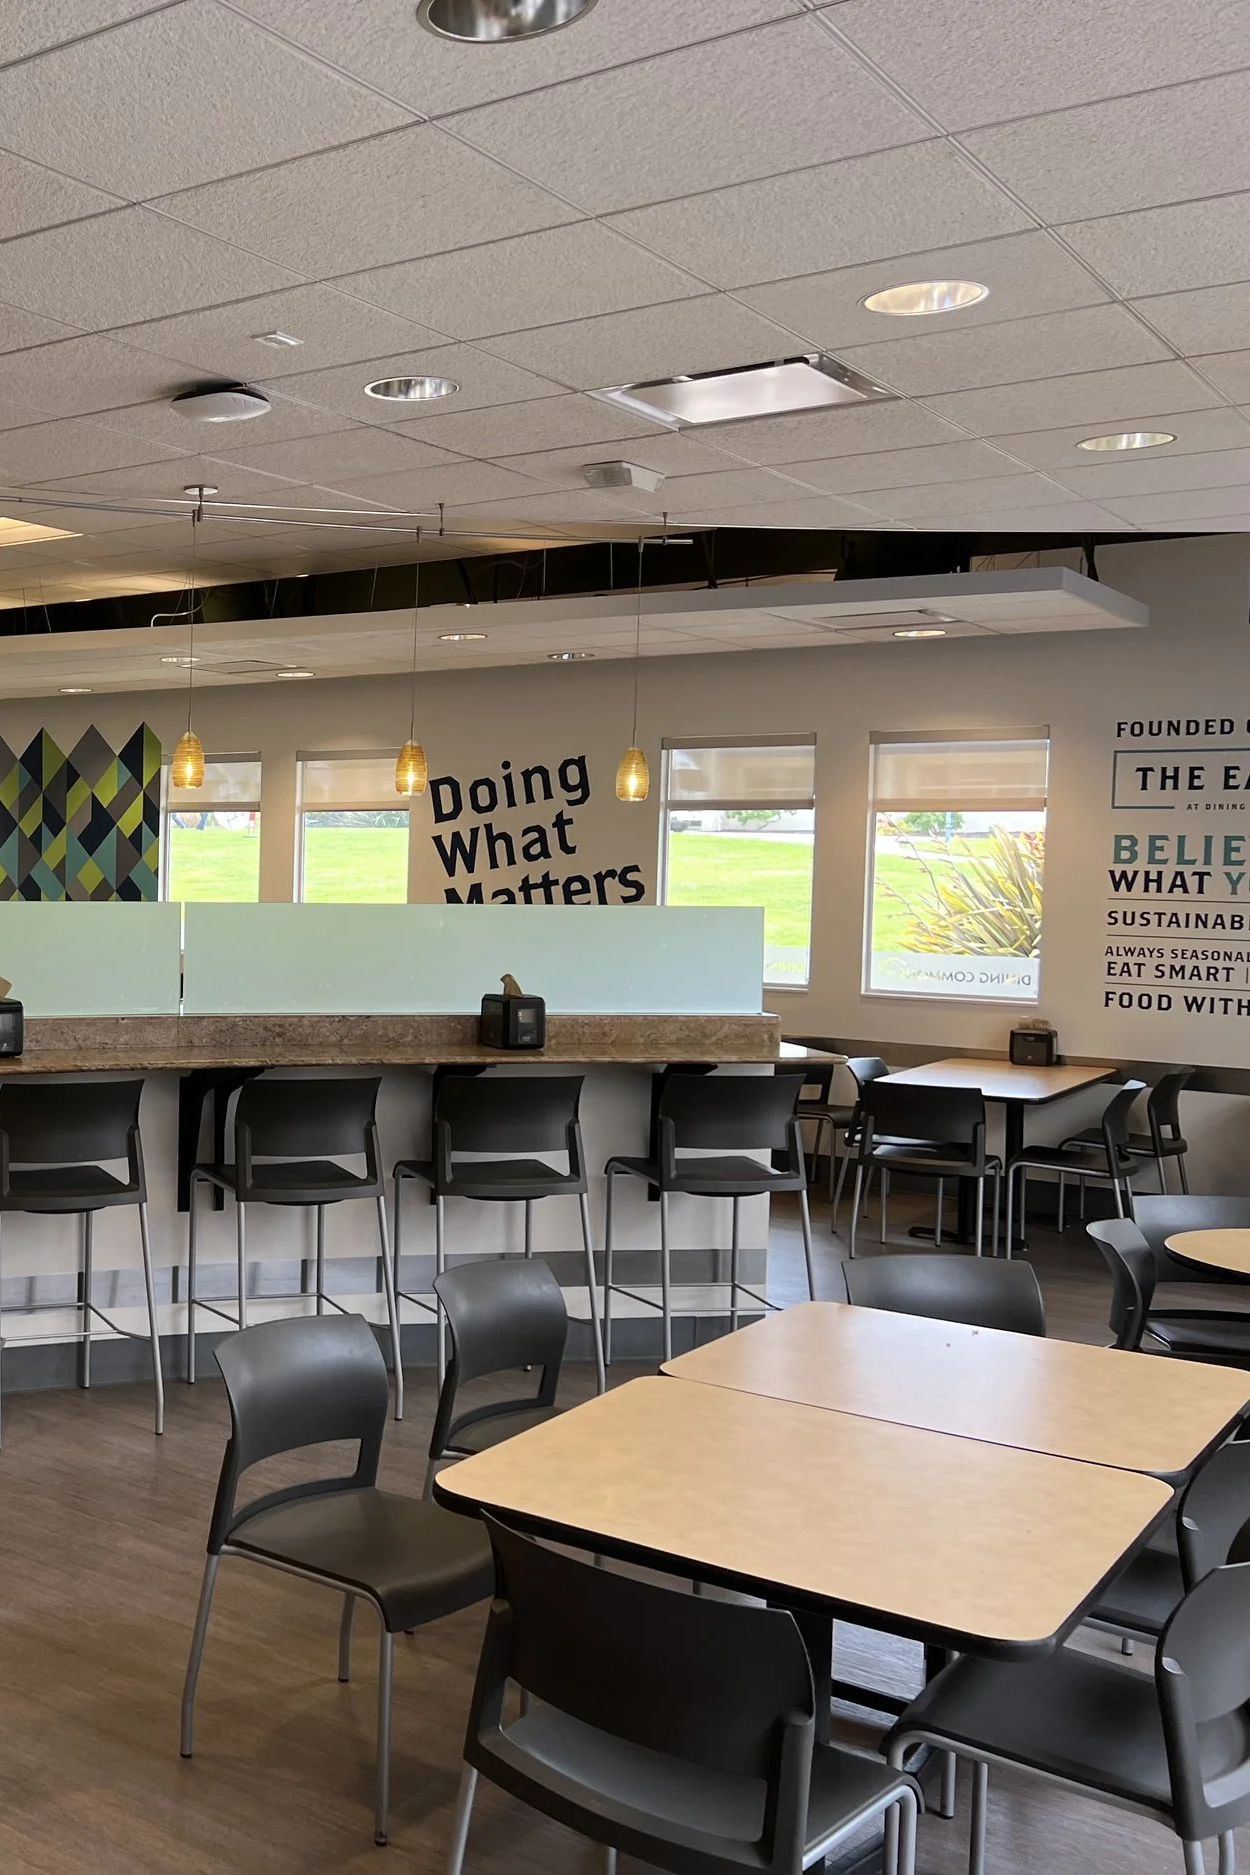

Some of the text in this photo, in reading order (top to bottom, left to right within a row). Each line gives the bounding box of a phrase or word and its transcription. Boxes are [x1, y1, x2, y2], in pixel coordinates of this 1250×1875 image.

[1117, 718, 1235, 738] FOUNDED
[429, 754, 591, 824] Doing
[1135, 766, 1206, 791] THE
[1186, 803, 1246, 811] AT DINING
[431, 808, 578, 878] What
[1112, 834, 1250, 867] BELIE
[443, 863, 646, 905] Matters
[1108, 870, 1250, 896] WHAT Y
[1106, 910, 1250, 931] SUSTAINAB
[1104, 946, 1165, 959] ALWAYS
[1106, 961, 1236, 983] EAT SMART
[1103, 991, 1173, 1012] FOOD
